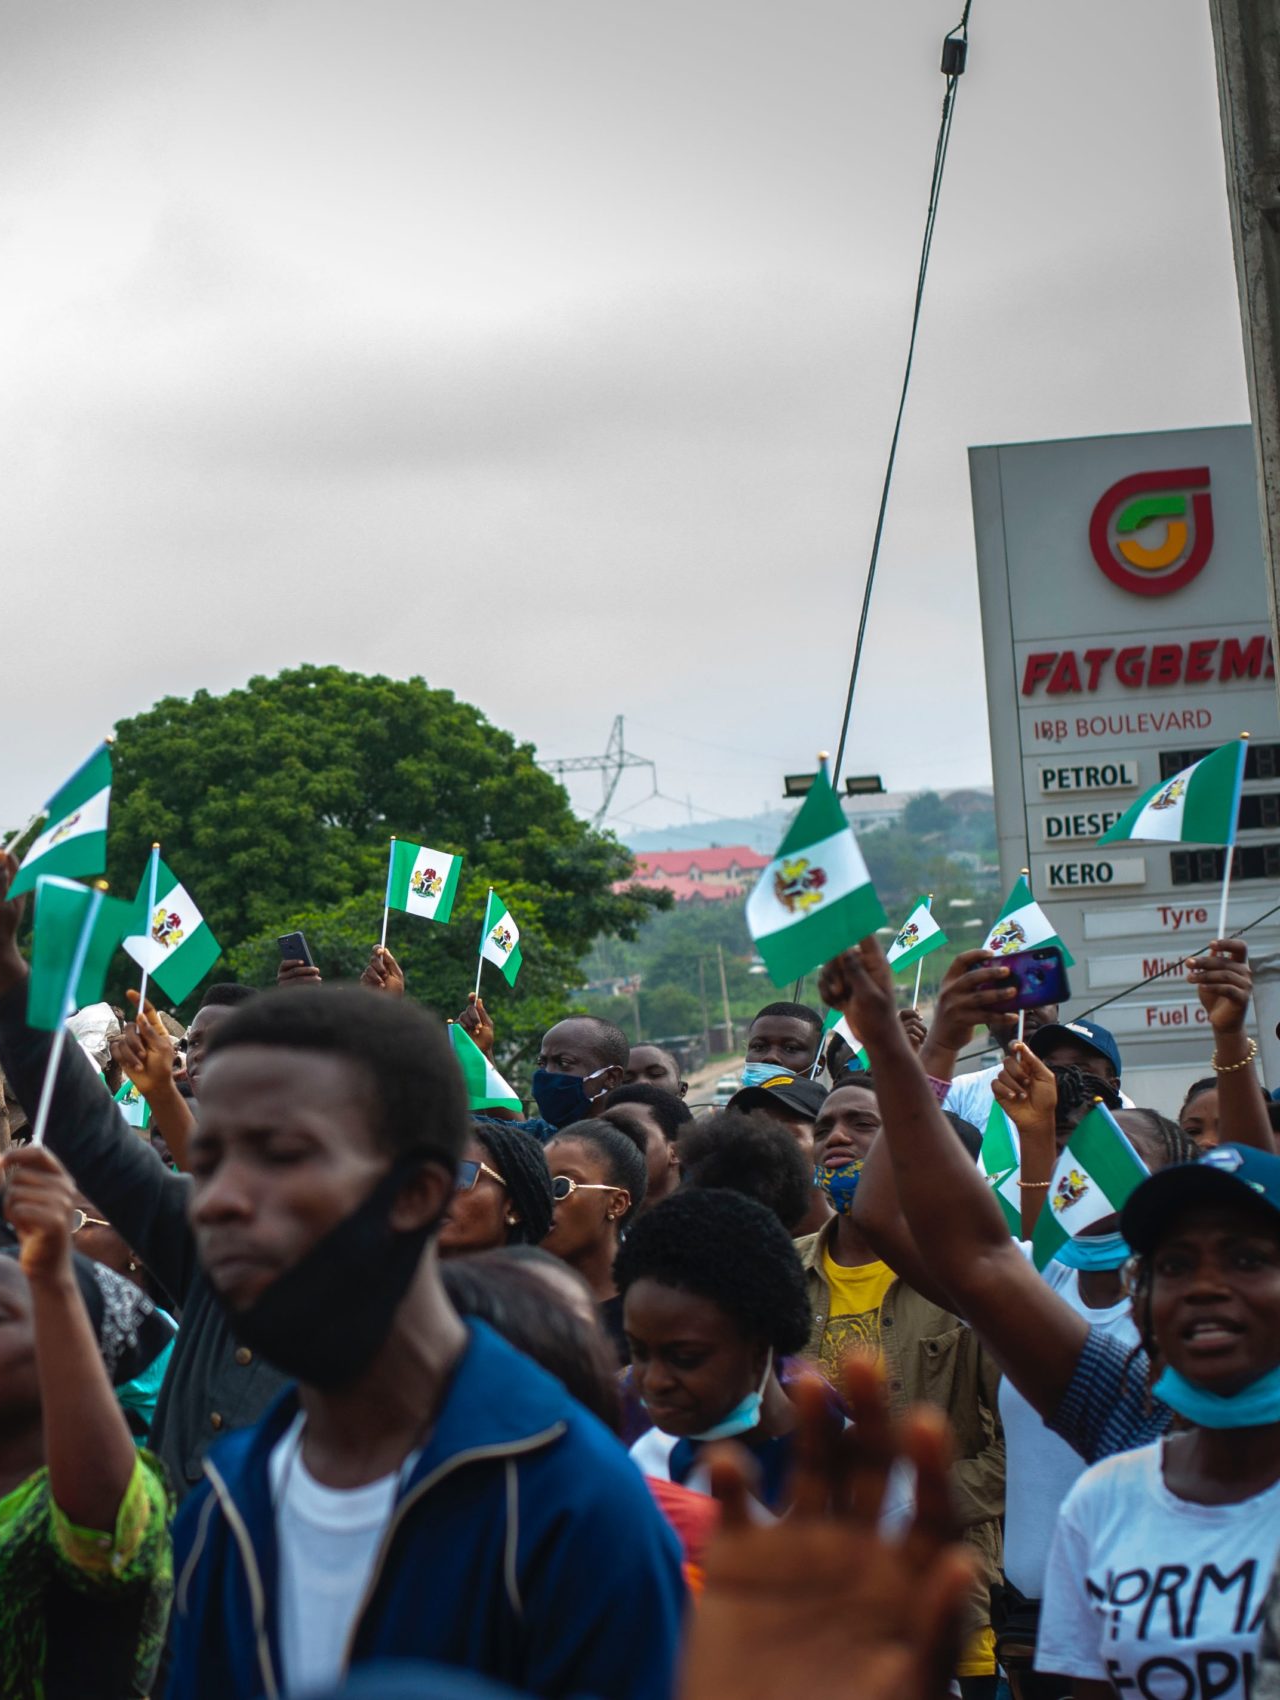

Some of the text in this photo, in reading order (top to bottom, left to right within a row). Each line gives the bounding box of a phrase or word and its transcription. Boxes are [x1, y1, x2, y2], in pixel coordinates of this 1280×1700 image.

[1022, 634, 1274, 695] FATGBEM
[1075, 709, 1212, 738] BOULEVARD
[1042, 764, 1132, 789] PETROL
[1049, 862, 1113, 885] KERO
[1157, 906, 1208, 929] Tyre
[1142, 956, 1184, 977] Mini
[1146, 1004, 1211, 1027] Fuel c
